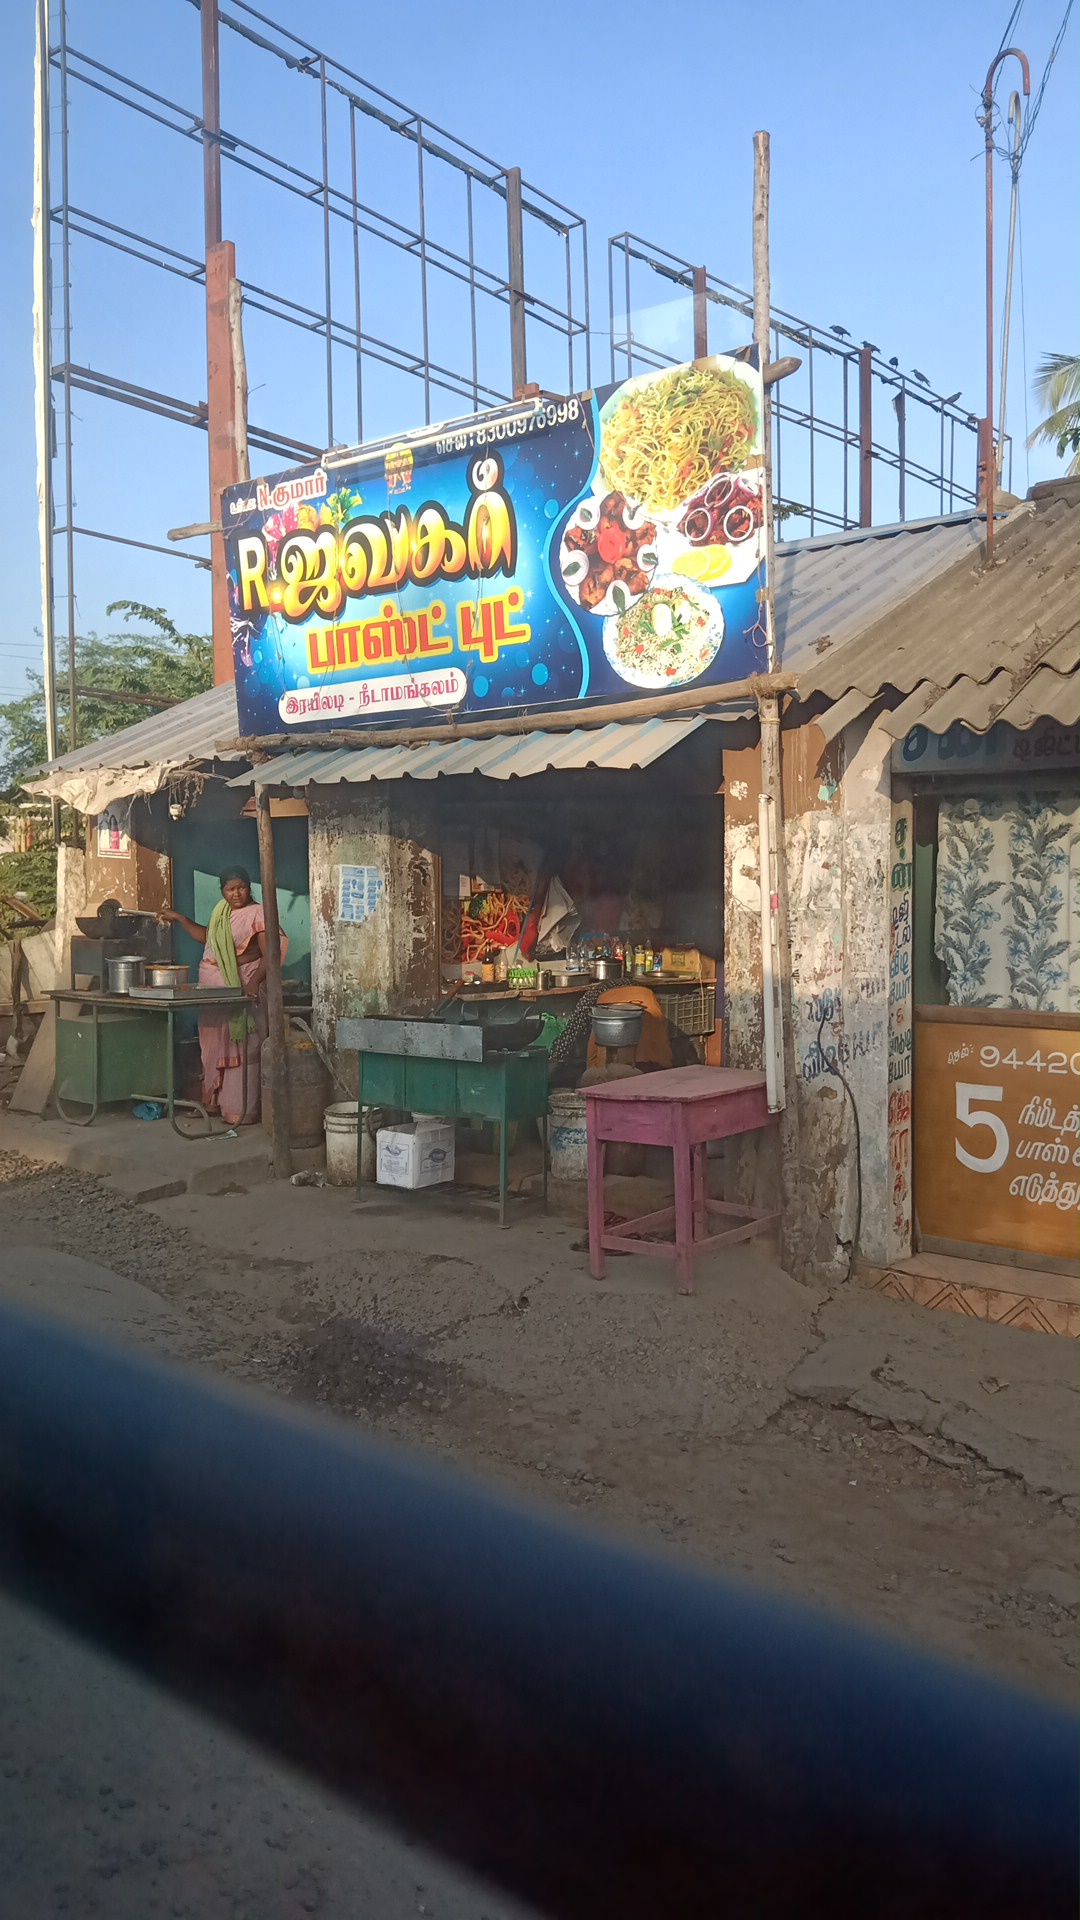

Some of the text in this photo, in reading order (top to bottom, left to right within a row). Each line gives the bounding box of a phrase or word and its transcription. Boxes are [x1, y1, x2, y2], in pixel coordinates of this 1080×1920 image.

[307, 590, 529, 671] பாஸ்ட் புட்
[285, 691, 346, 716] இரயிலடி
[358, 671, 459, 709] நீடாமங்கலம்
[955, 1081, 1010, 1174] 5
